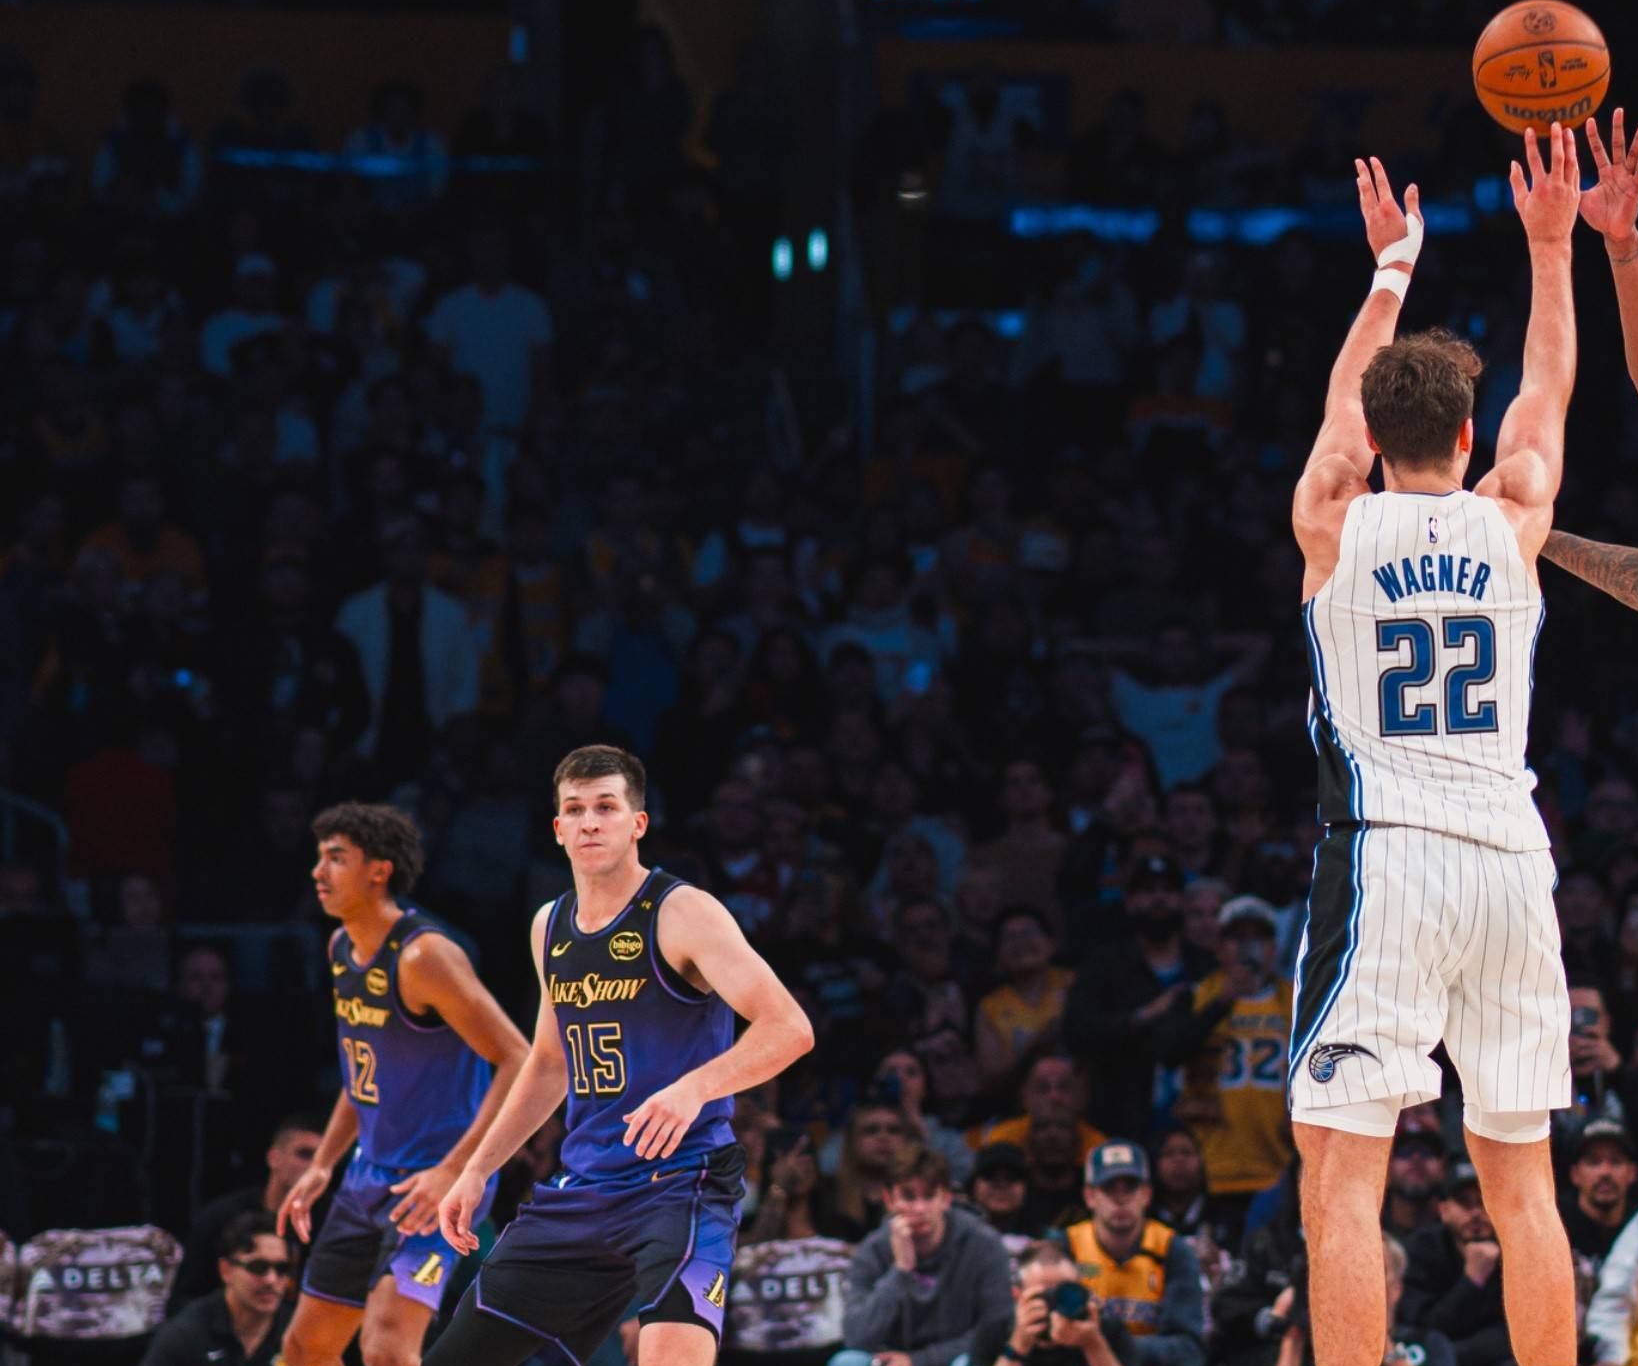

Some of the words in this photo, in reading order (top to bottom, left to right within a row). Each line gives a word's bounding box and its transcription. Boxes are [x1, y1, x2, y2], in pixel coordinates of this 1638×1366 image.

[1503, 95, 1592, 123] Wilson
[1372, 553, 1491, 603] WAGNER
[1376, 615, 1499, 737] 22
[342, 1037, 380, 1104] 12
[566, 1022, 626, 1093] 15
[62, 1264, 164, 1291] DELTA
